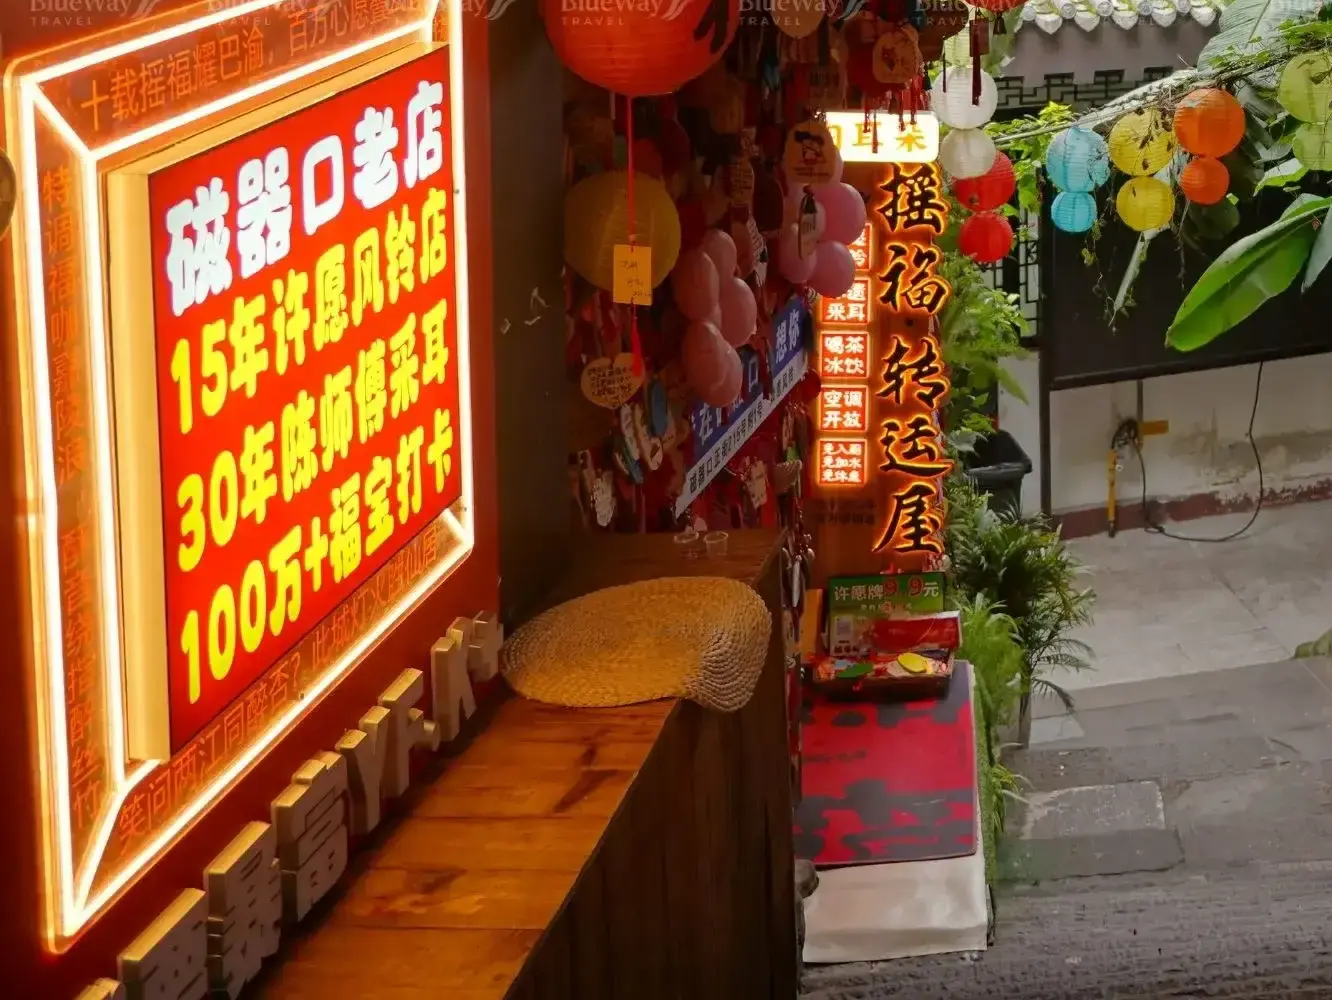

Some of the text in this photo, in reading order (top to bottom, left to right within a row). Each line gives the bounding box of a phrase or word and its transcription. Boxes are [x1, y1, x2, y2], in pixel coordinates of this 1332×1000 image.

[166, 80, 445, 316] 磁器口老店
[172, 187, 448, 435] 15年许愿风铃店
[177, 298, 449, 573] 30年陈师傅采耳
[824, 355, 865, 375] 冰饮
[824, 410, 862, 429] 开放
[825, 390, 863, 408] 空调
[181, 408, 454, 706] 100万+福宝打卡
